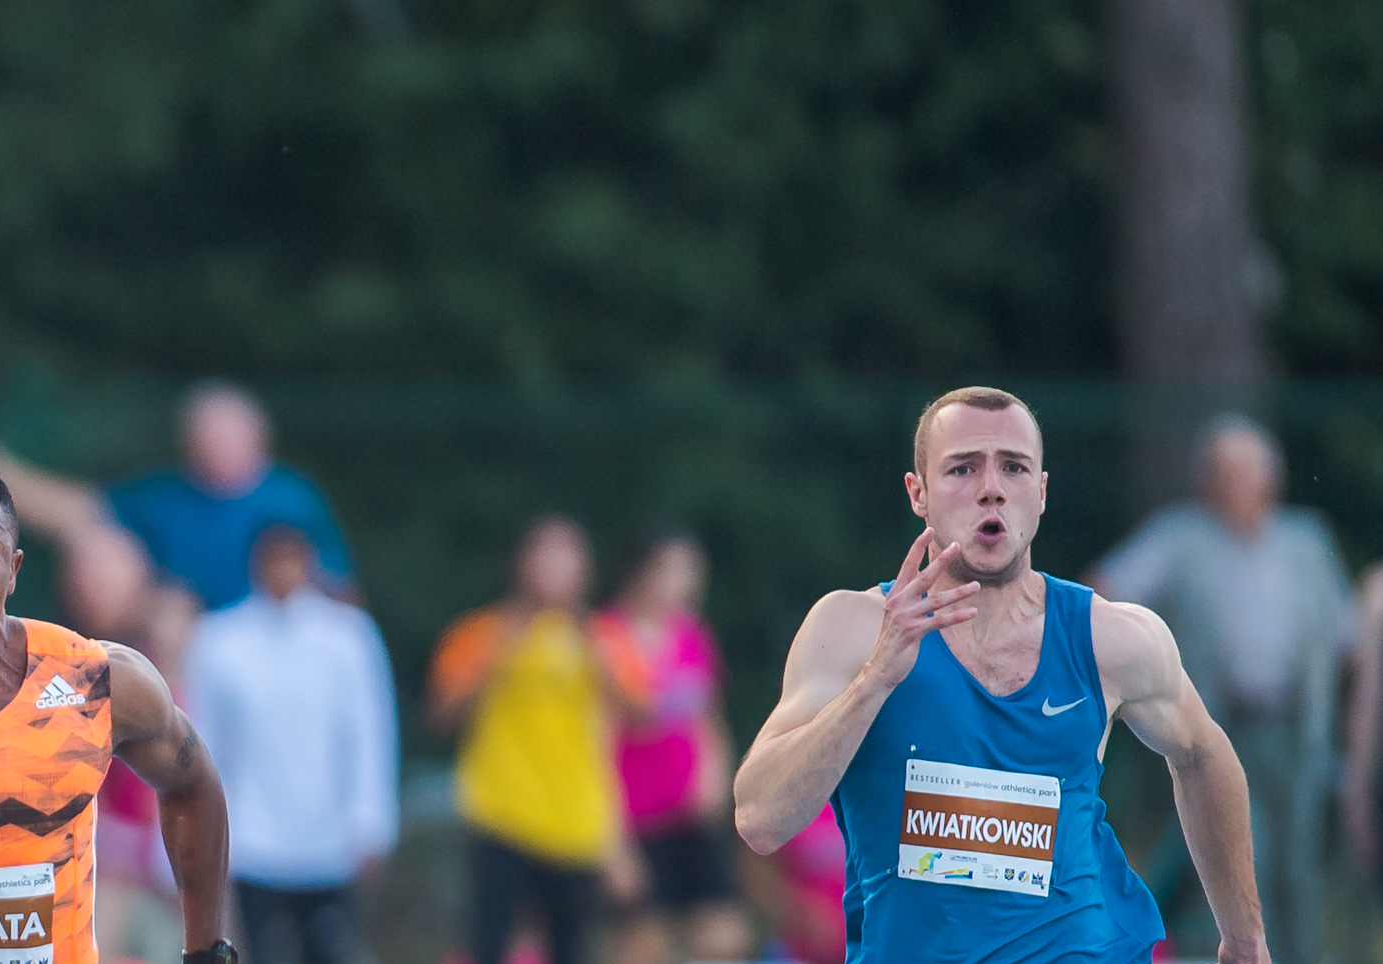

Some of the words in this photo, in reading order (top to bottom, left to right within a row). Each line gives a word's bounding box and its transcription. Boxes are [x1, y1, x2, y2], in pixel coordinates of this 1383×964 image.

[35, 693, 86, 709] adidas
[910, 774, 962, 786] BESTSELLER
[964, 780, 1000, 790] goleniów
[1001, 784, 1037, 795] athletics
[1038, 789, 1058, 798] park
[906, 808, 1053, 850] KWIATKOWSKI
